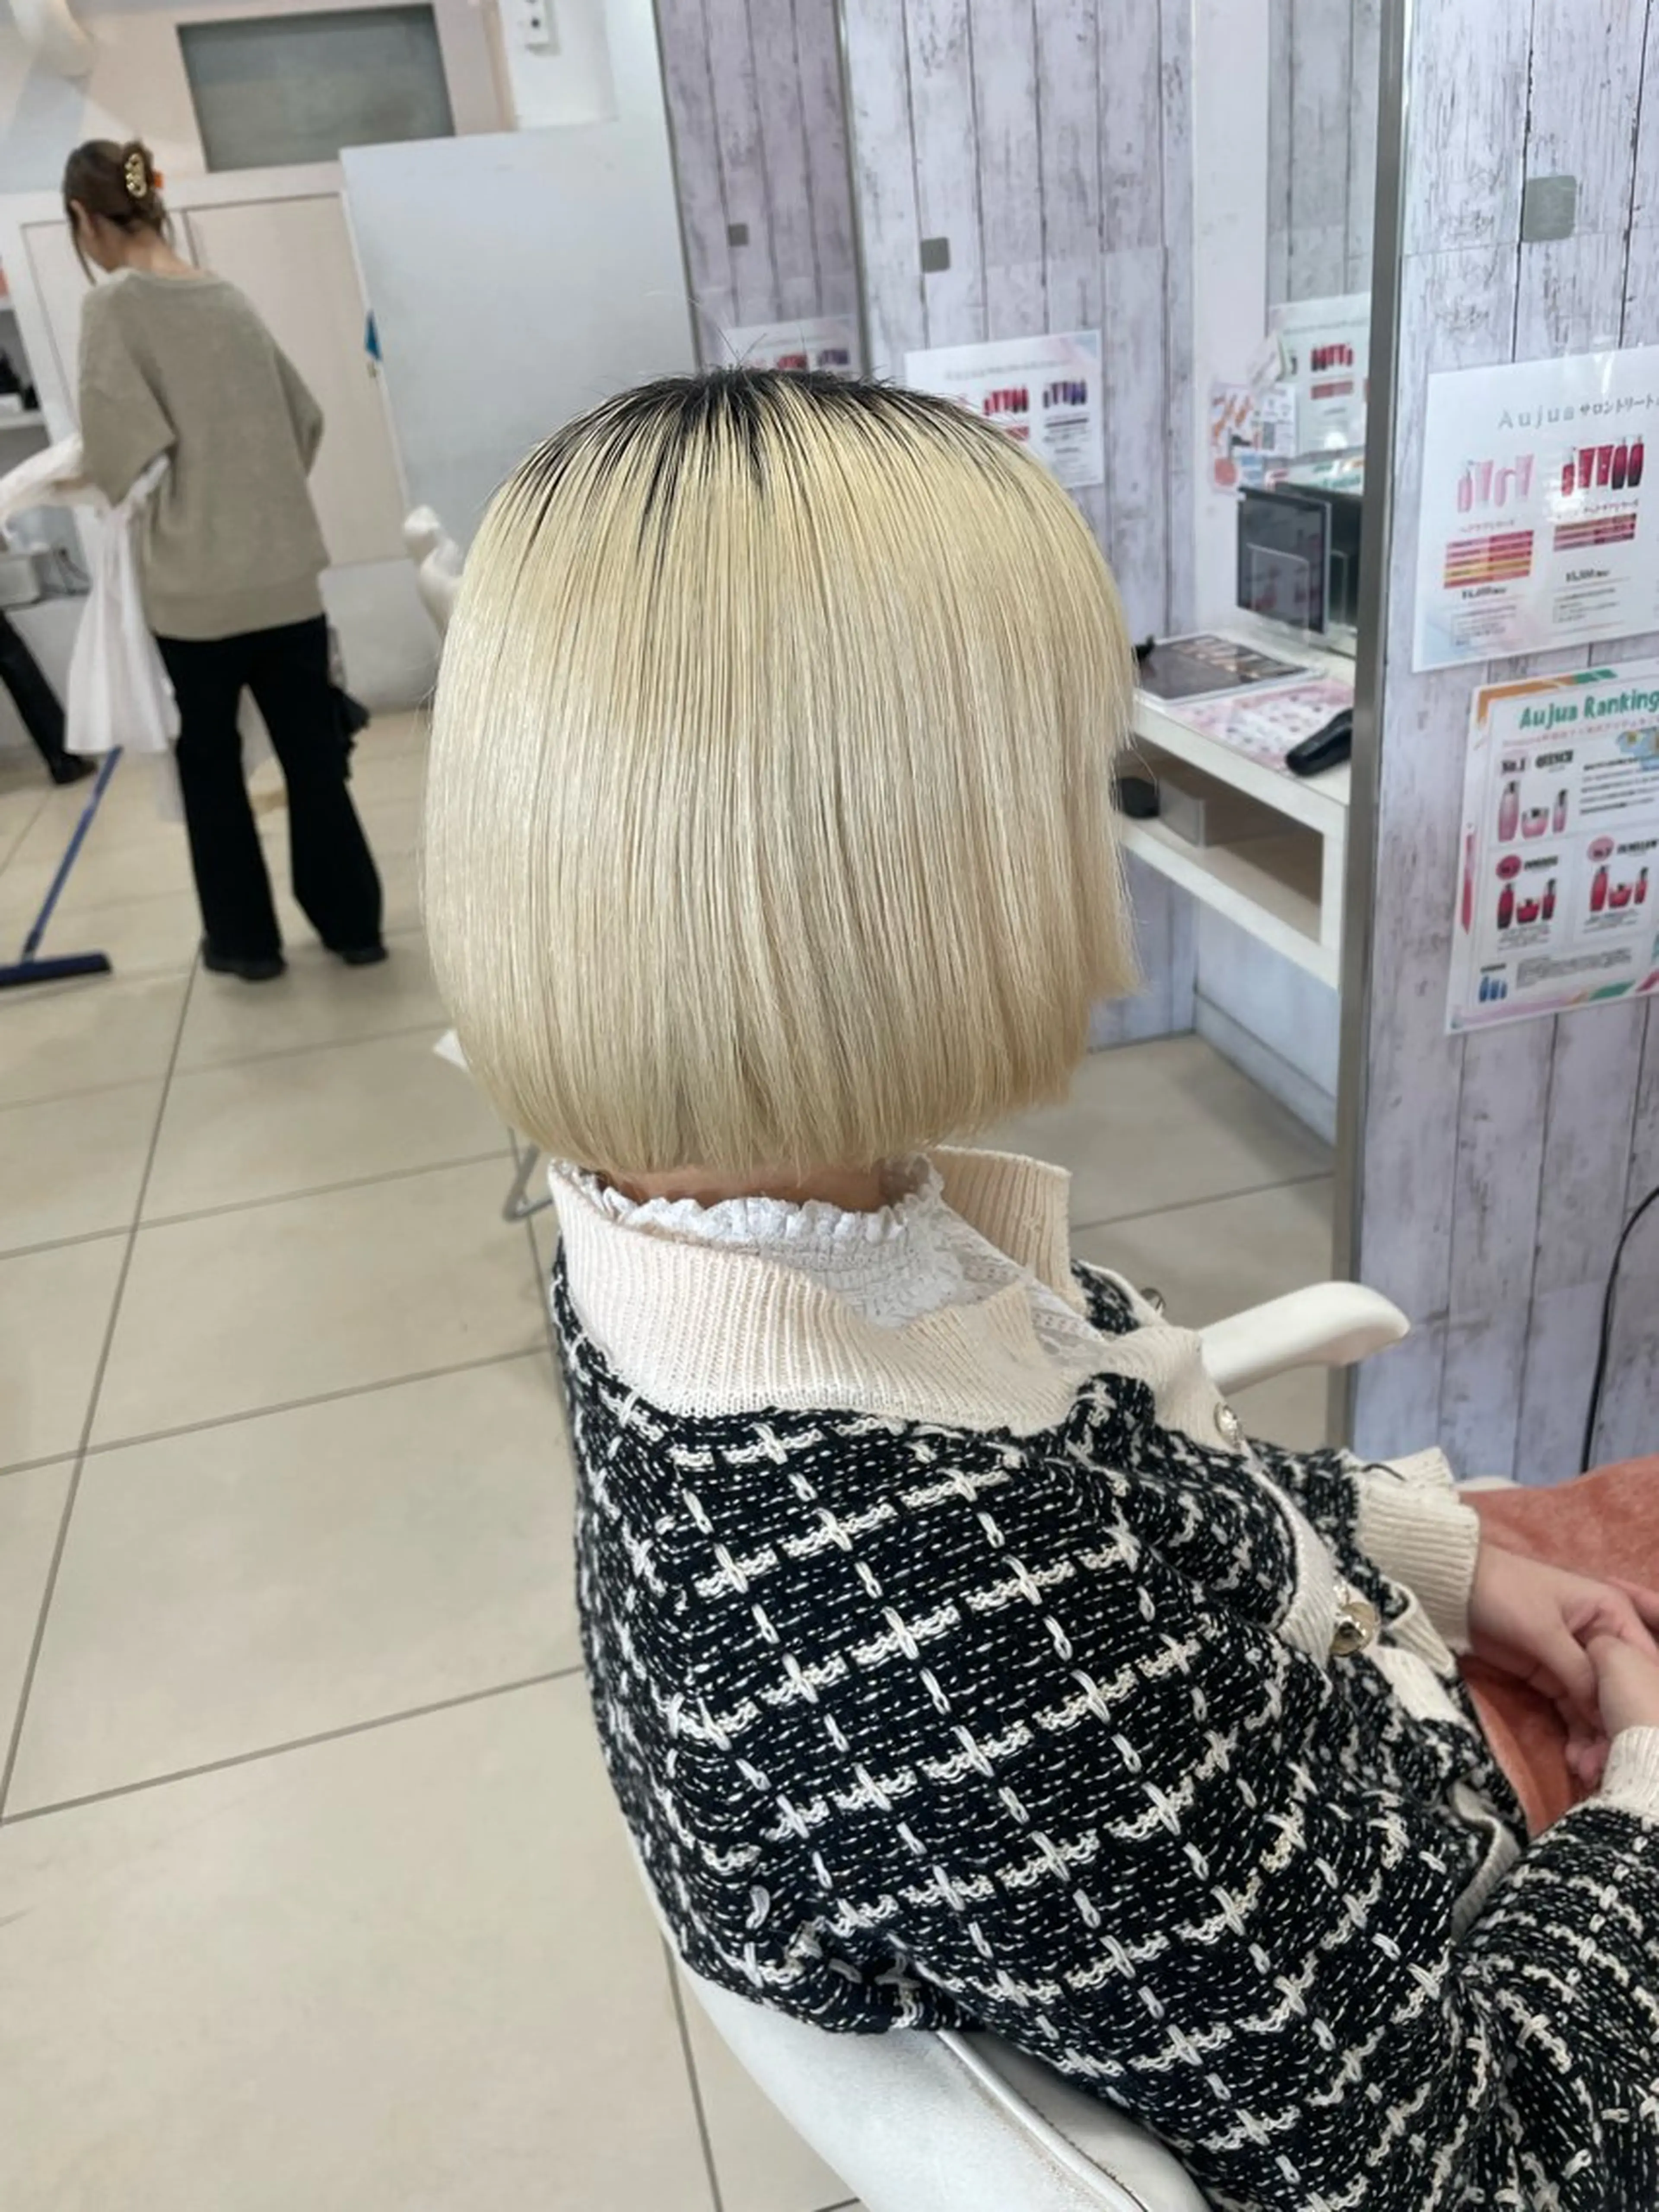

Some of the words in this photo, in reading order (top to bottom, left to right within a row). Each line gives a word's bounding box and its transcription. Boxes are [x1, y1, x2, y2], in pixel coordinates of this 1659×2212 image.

[1497, 405, 1575, 429] Aujua
[1519, 702, 1578, 730] Aujua
[1584, 689, 1659, 719] Ranking
